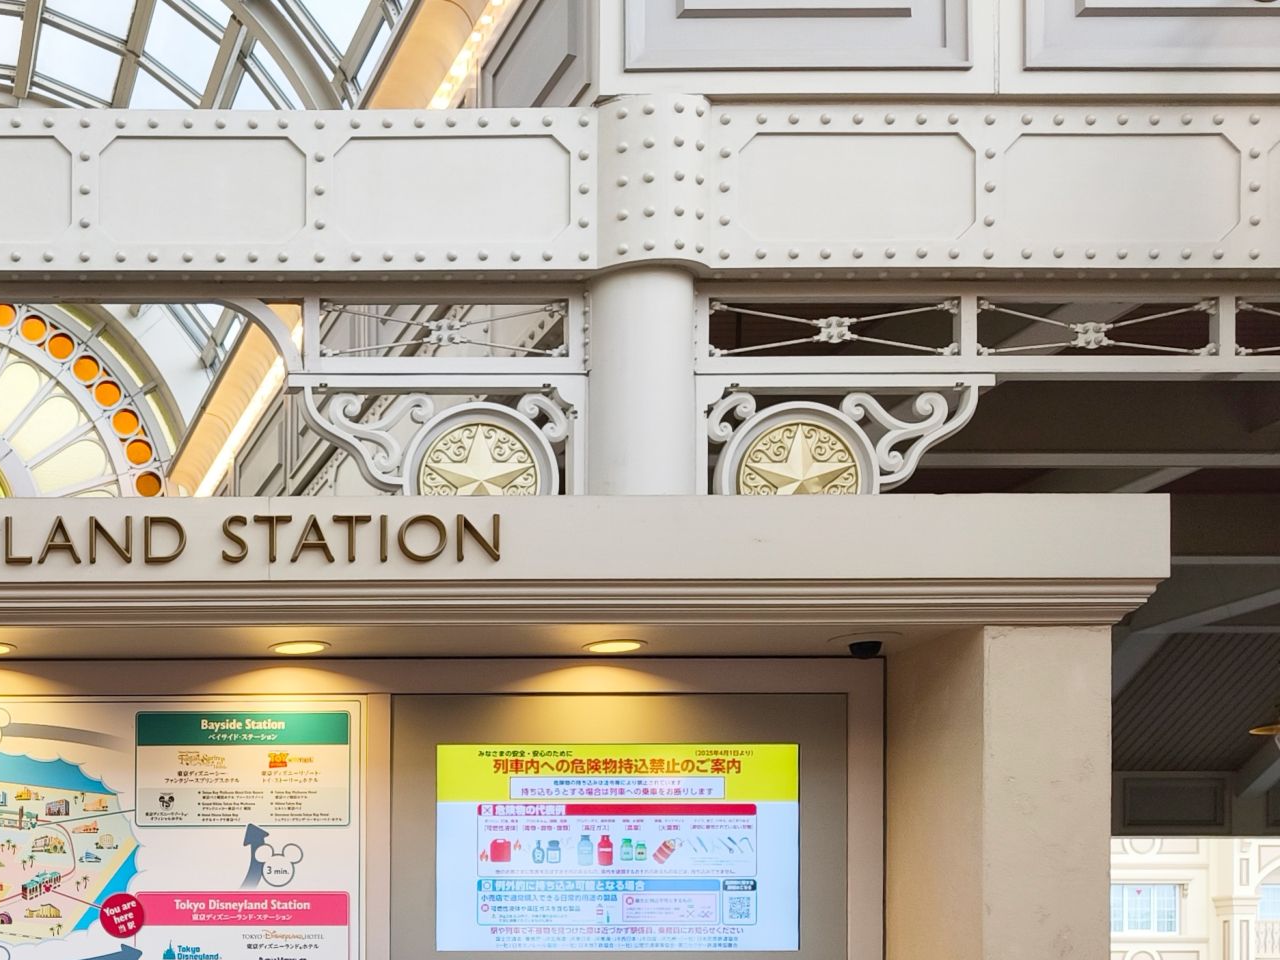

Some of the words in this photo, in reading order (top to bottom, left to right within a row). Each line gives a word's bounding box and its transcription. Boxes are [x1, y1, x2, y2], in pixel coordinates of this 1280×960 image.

[221, 513, 501, 563] STATION
[201, 719, 242, 733] Bayside
[245, 719, 285, 730] Station
[493, 758, 741, 774] 列車内への危険物持込禁止のご案内
[267, 866, 273, 875] 3
[103, 904, 120, 917] You
[120, 899, 137, 911] are
[174, 899, 206, 912] Tokyo
[208, 899, 269, 912] Disneyland
[271, 899, 310, 910] Station
[114, 910, 134, 924] here
[178, 945, 200, 954] Tokyo
